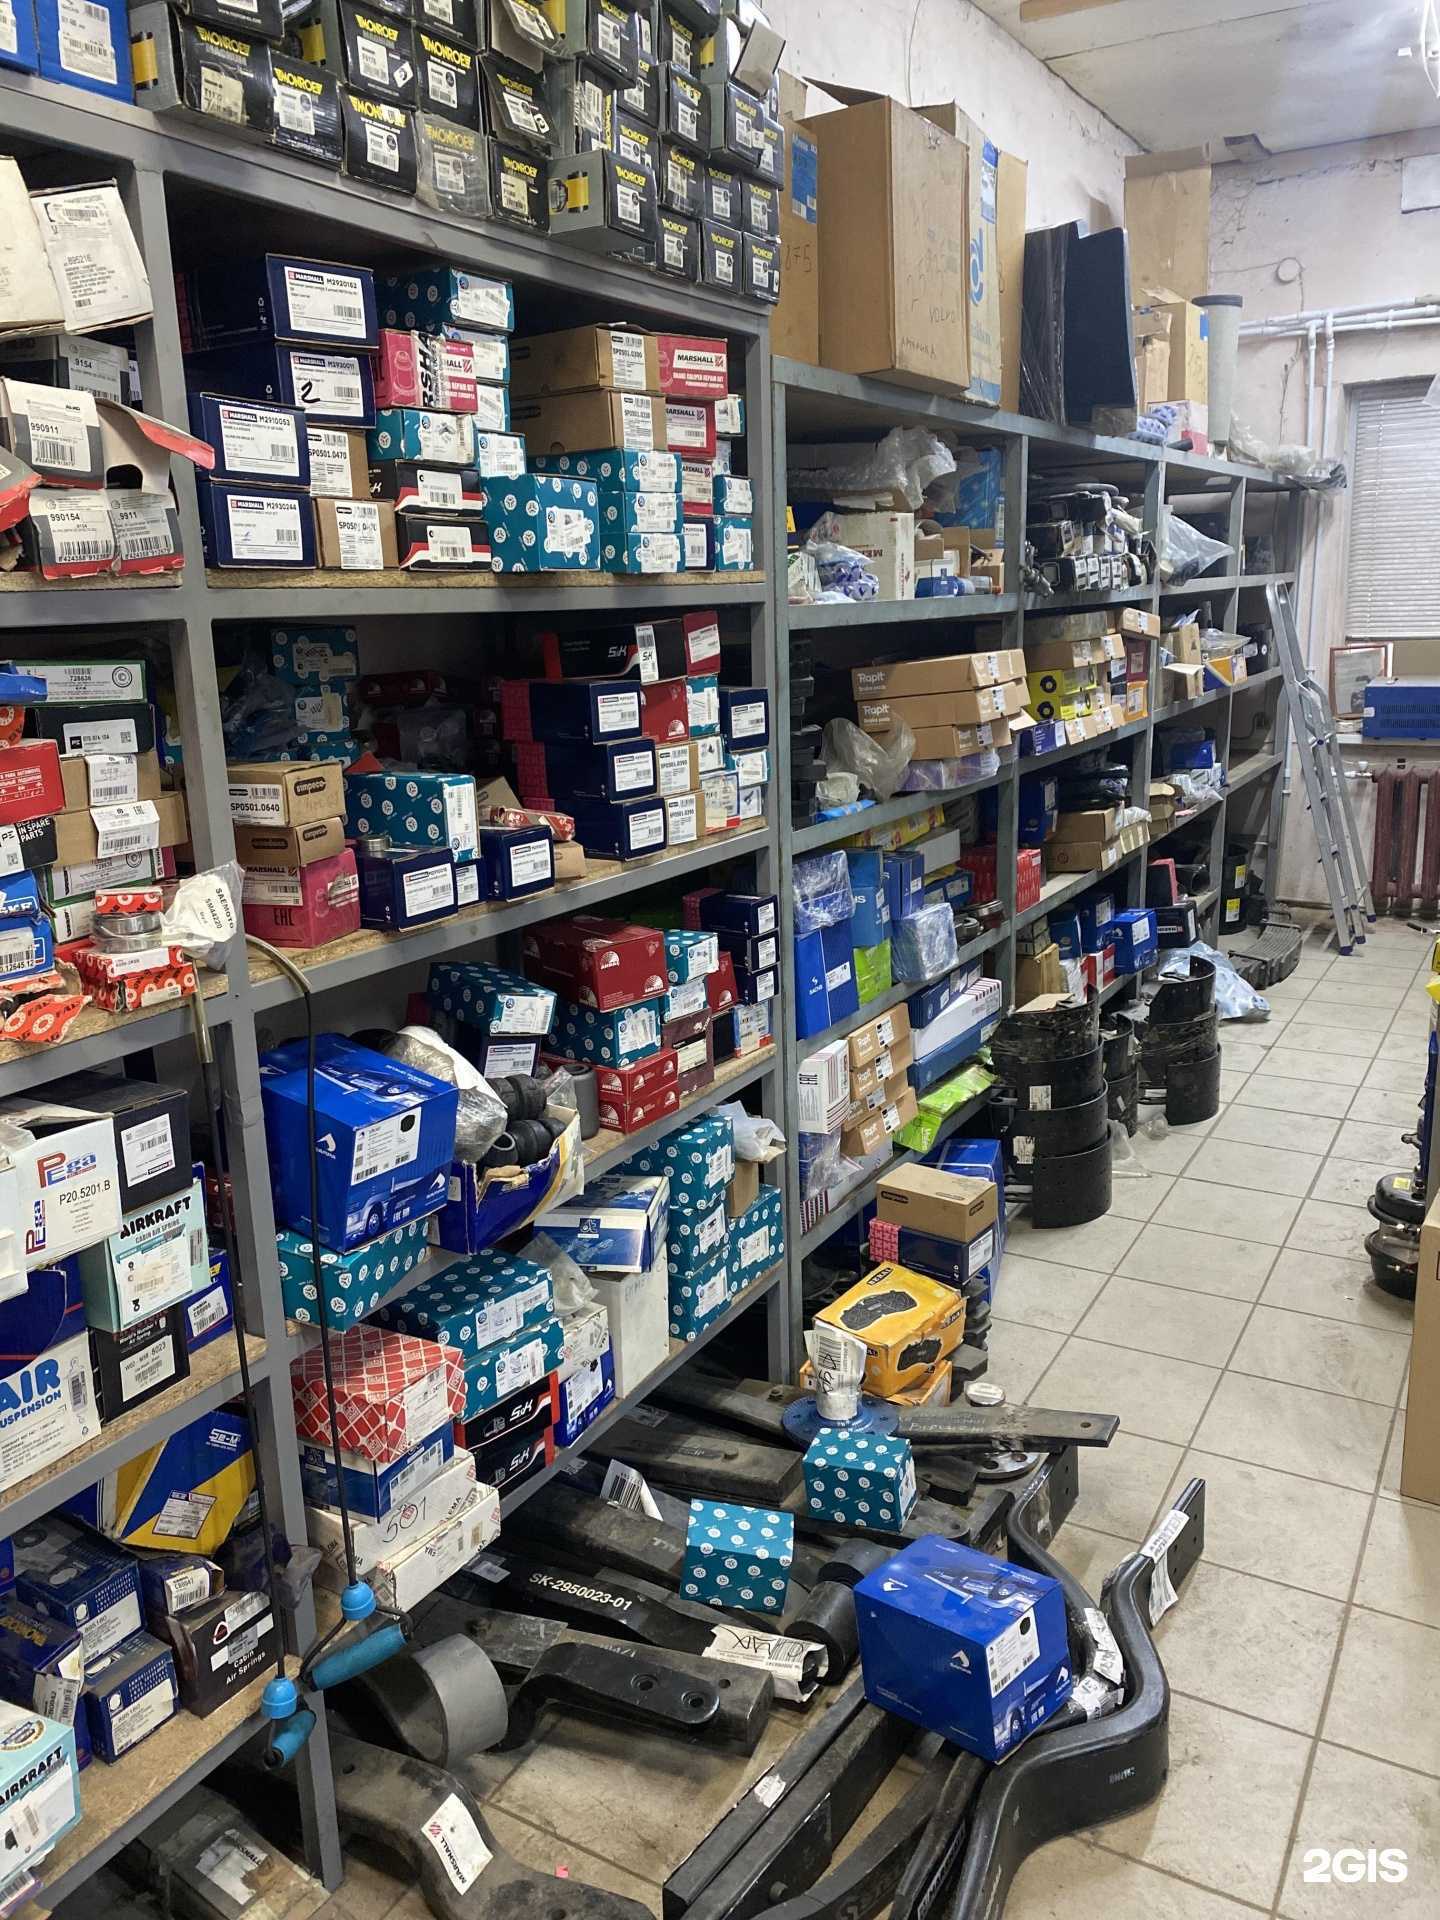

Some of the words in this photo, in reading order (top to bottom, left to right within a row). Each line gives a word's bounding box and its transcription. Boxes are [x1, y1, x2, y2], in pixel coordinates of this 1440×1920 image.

[196, 26, 250, 57] MONROE
[355, 14, 399, 41] MONROE
[421, 34, 472, 69] MONROE
[274, 68, 322, 95] MONROE
[503, 156, 538, 178] MONROE
[616, 165, 646, 187] MONROE
[677, 354, 714, 363] MARSHALL
[20, 829, 44, 843] PARTS
[27, 818, 51, 832] SPARE
[216, 888, 234, 929] SAEMOTO
[59, 1180, 111, 1206] P20.5201.B
[119, 1196, 192, 1239] AIRKRAFT
[0, 1390, 62, 1429] USPENSION
[530, 1572, 633, 1611] SK-2950023-01
[226, 1674, 238, 1686] Air
[238, 1651, 266, 1677] Springs
[440, 1836, 468, 1885] MARSHALL
